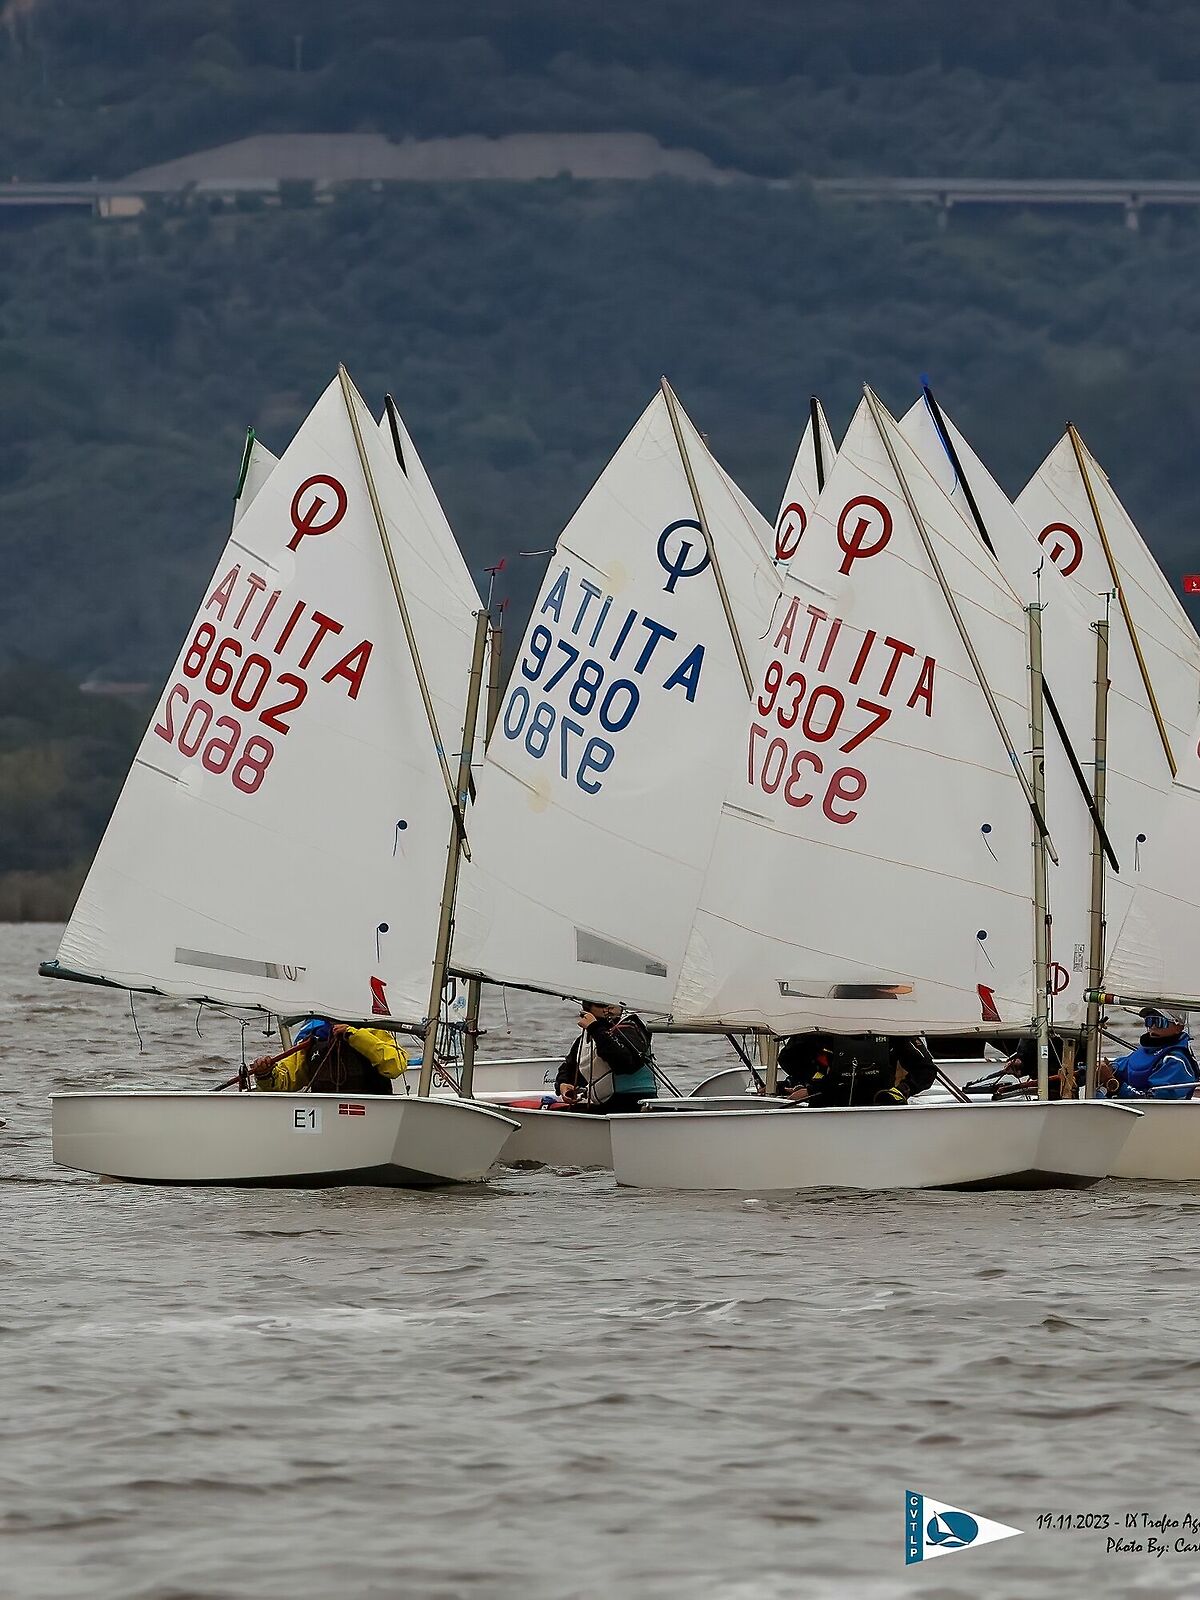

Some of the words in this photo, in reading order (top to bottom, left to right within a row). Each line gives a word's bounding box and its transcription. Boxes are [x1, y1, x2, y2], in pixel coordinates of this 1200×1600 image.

[181, 623, 309, 735] 8602
[273, 601, 373, 700] ITA
[521, 625, 640, 732] 9780
[610, 609, 706, 702] ITA
[848, 630, 937, 717] ITA
[757, 660, 892, 753] 9307
[293, 1108, 317, 1128] E1
